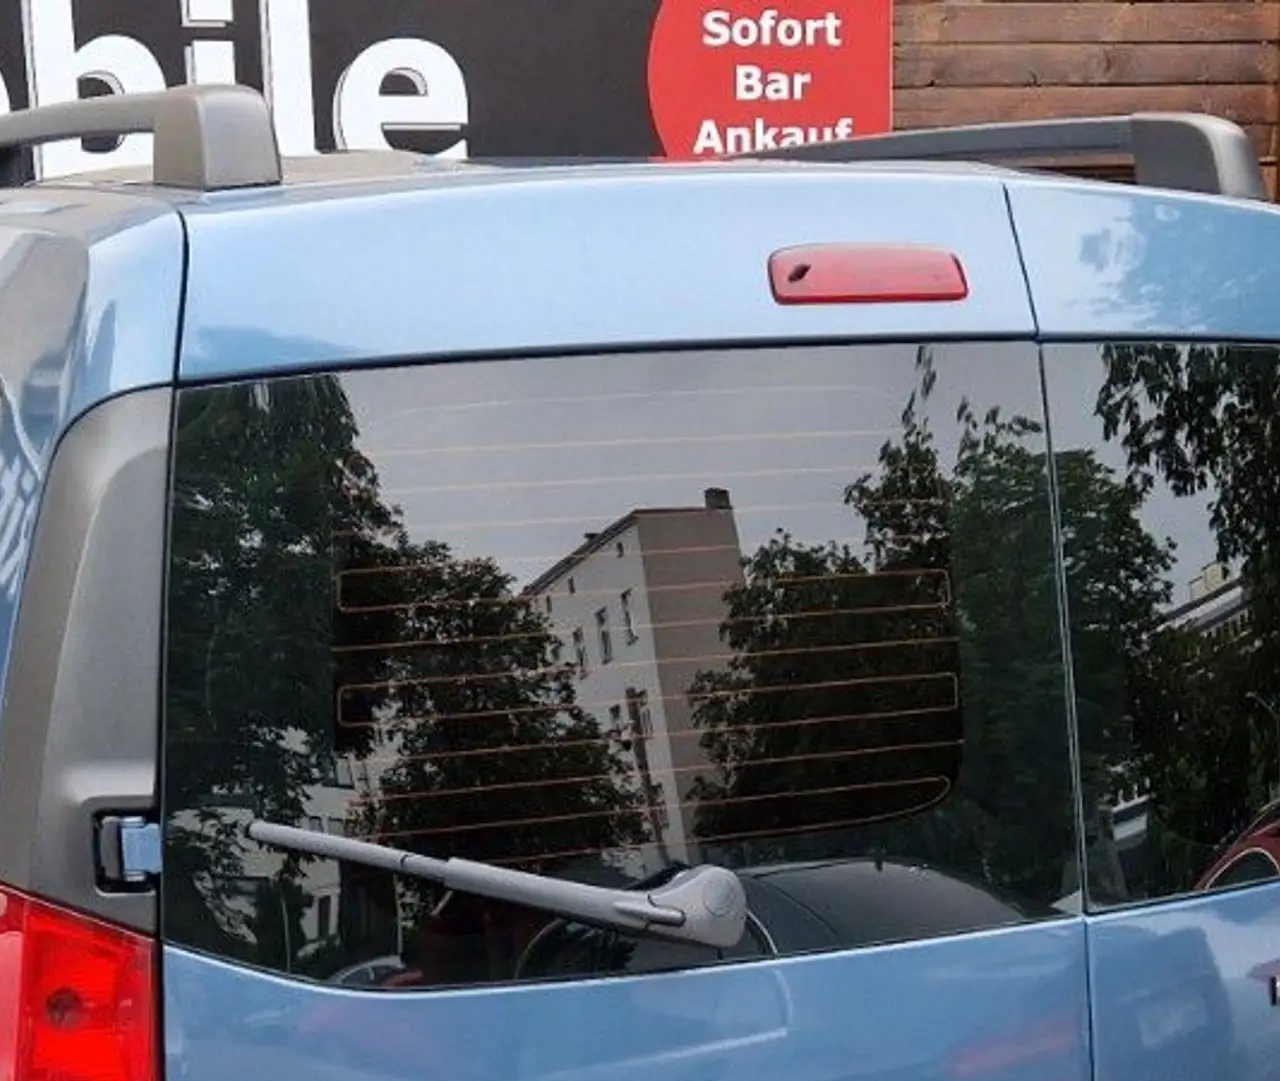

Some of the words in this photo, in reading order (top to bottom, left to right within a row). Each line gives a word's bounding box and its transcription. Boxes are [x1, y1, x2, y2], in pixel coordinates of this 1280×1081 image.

[702, 9, 842, 46] Sofort
[736, 64, 811, 100] Bar
[693, 117, 853, 154] Ankauf
